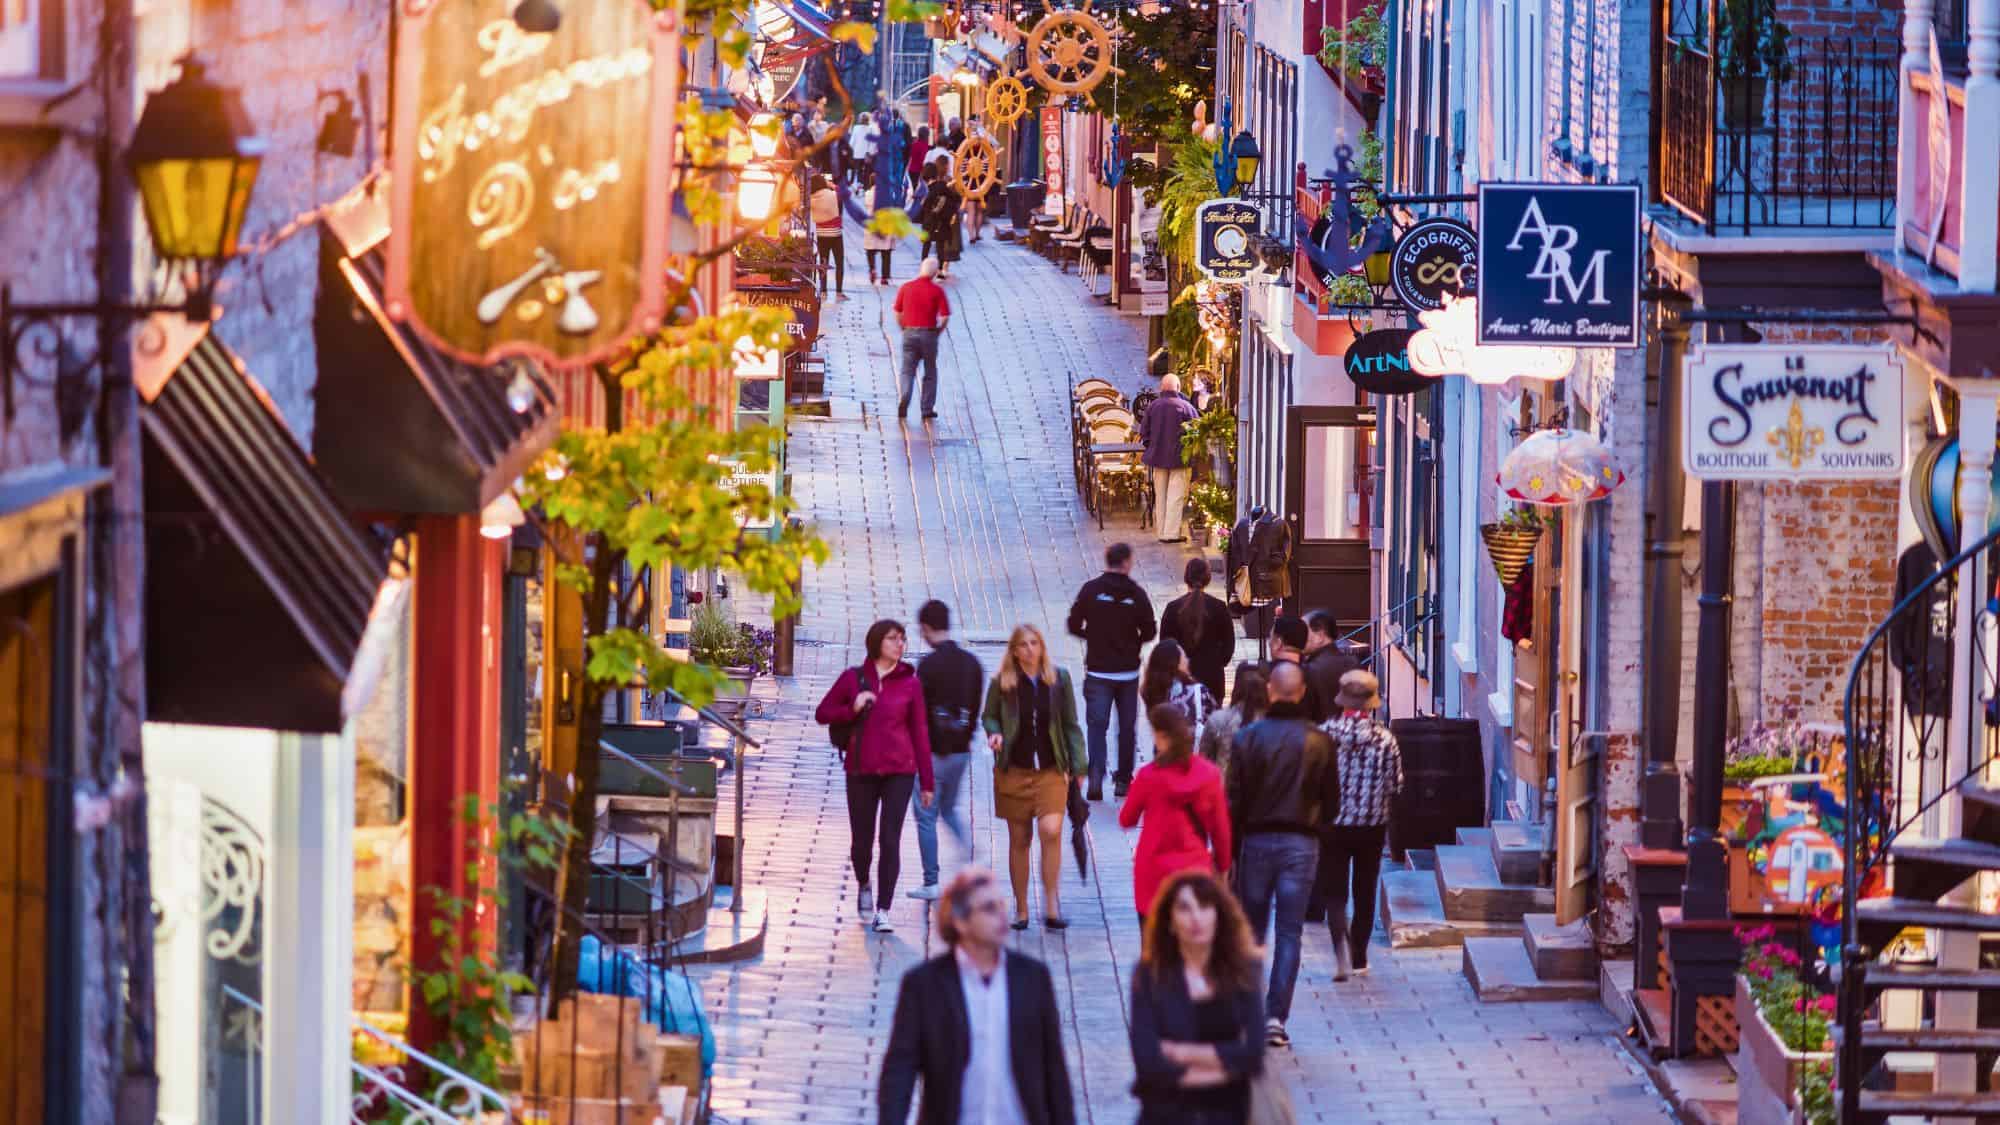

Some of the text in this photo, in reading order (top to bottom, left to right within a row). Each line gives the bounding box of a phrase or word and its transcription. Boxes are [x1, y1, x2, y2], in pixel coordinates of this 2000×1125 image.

[1403, 231, 1476, 264] ECOGRIFFE
[1576, 318, 1630, 341] Boutique
[1348, 351, 1409, 373] ArtNi
[1784, 356, 1805, 369] LE
[1696, 452, 1895, 467] BOUTIQUE SOUVENIRS
